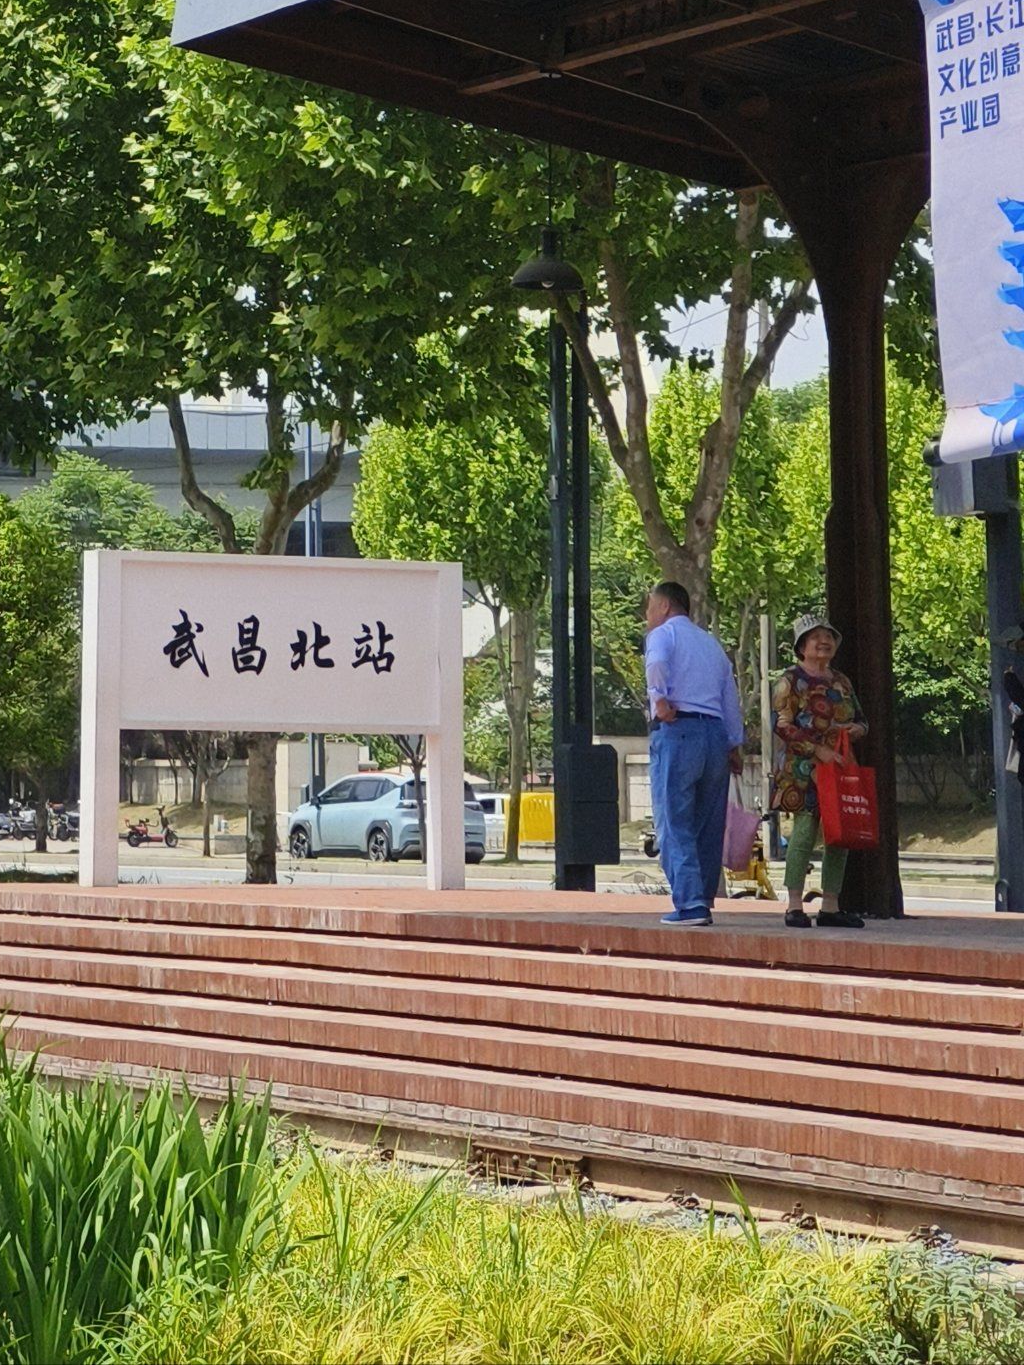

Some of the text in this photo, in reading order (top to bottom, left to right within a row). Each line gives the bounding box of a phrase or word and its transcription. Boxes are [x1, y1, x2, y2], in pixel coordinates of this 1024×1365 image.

[938, 42, 1021, 96] 文化创意
[939, 92, 1000, 139] 产业园
[163, 609, 395, 677] 武昌北站
